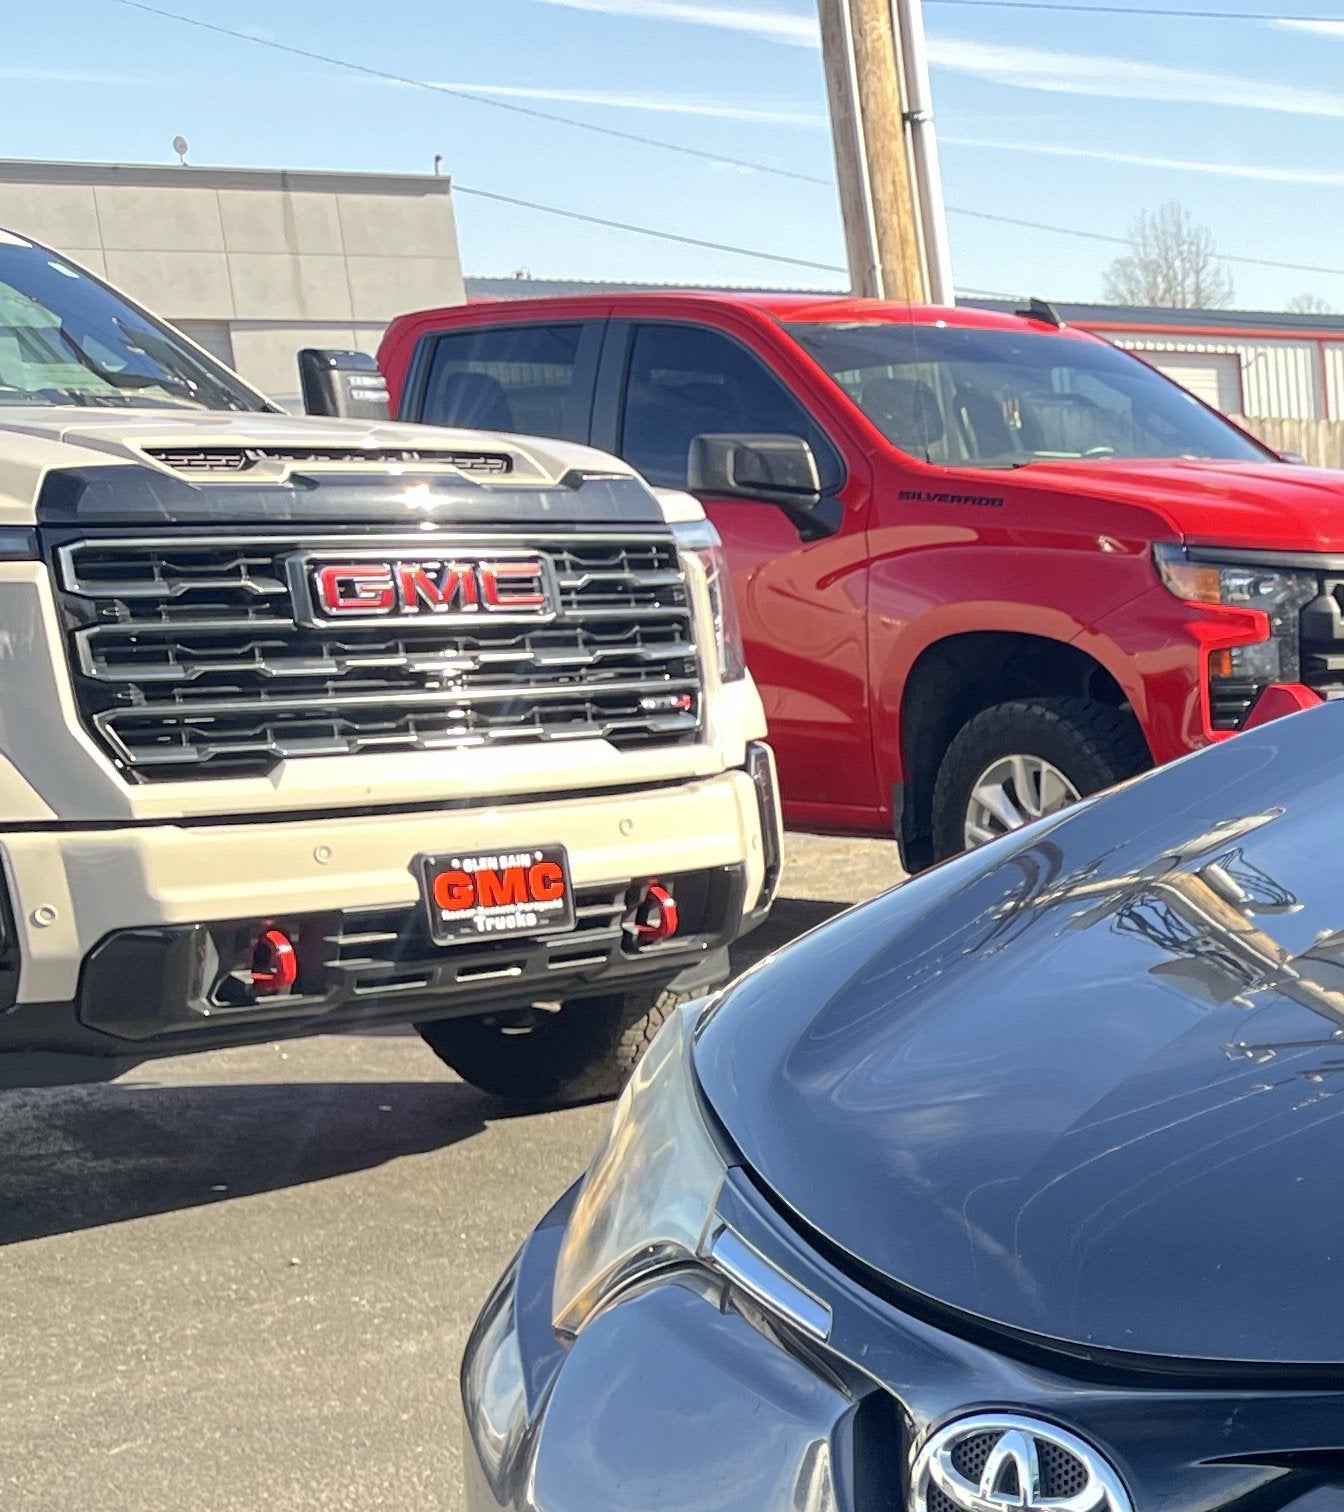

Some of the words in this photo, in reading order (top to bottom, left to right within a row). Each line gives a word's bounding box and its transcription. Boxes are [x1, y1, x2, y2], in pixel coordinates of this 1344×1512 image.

[899, 491, 1004, 507] SILVERADO
[317, 562, 545, 615] GMC
[434, 862, 565, 911] GMC
[473, 911, 537, 932] Trucks
